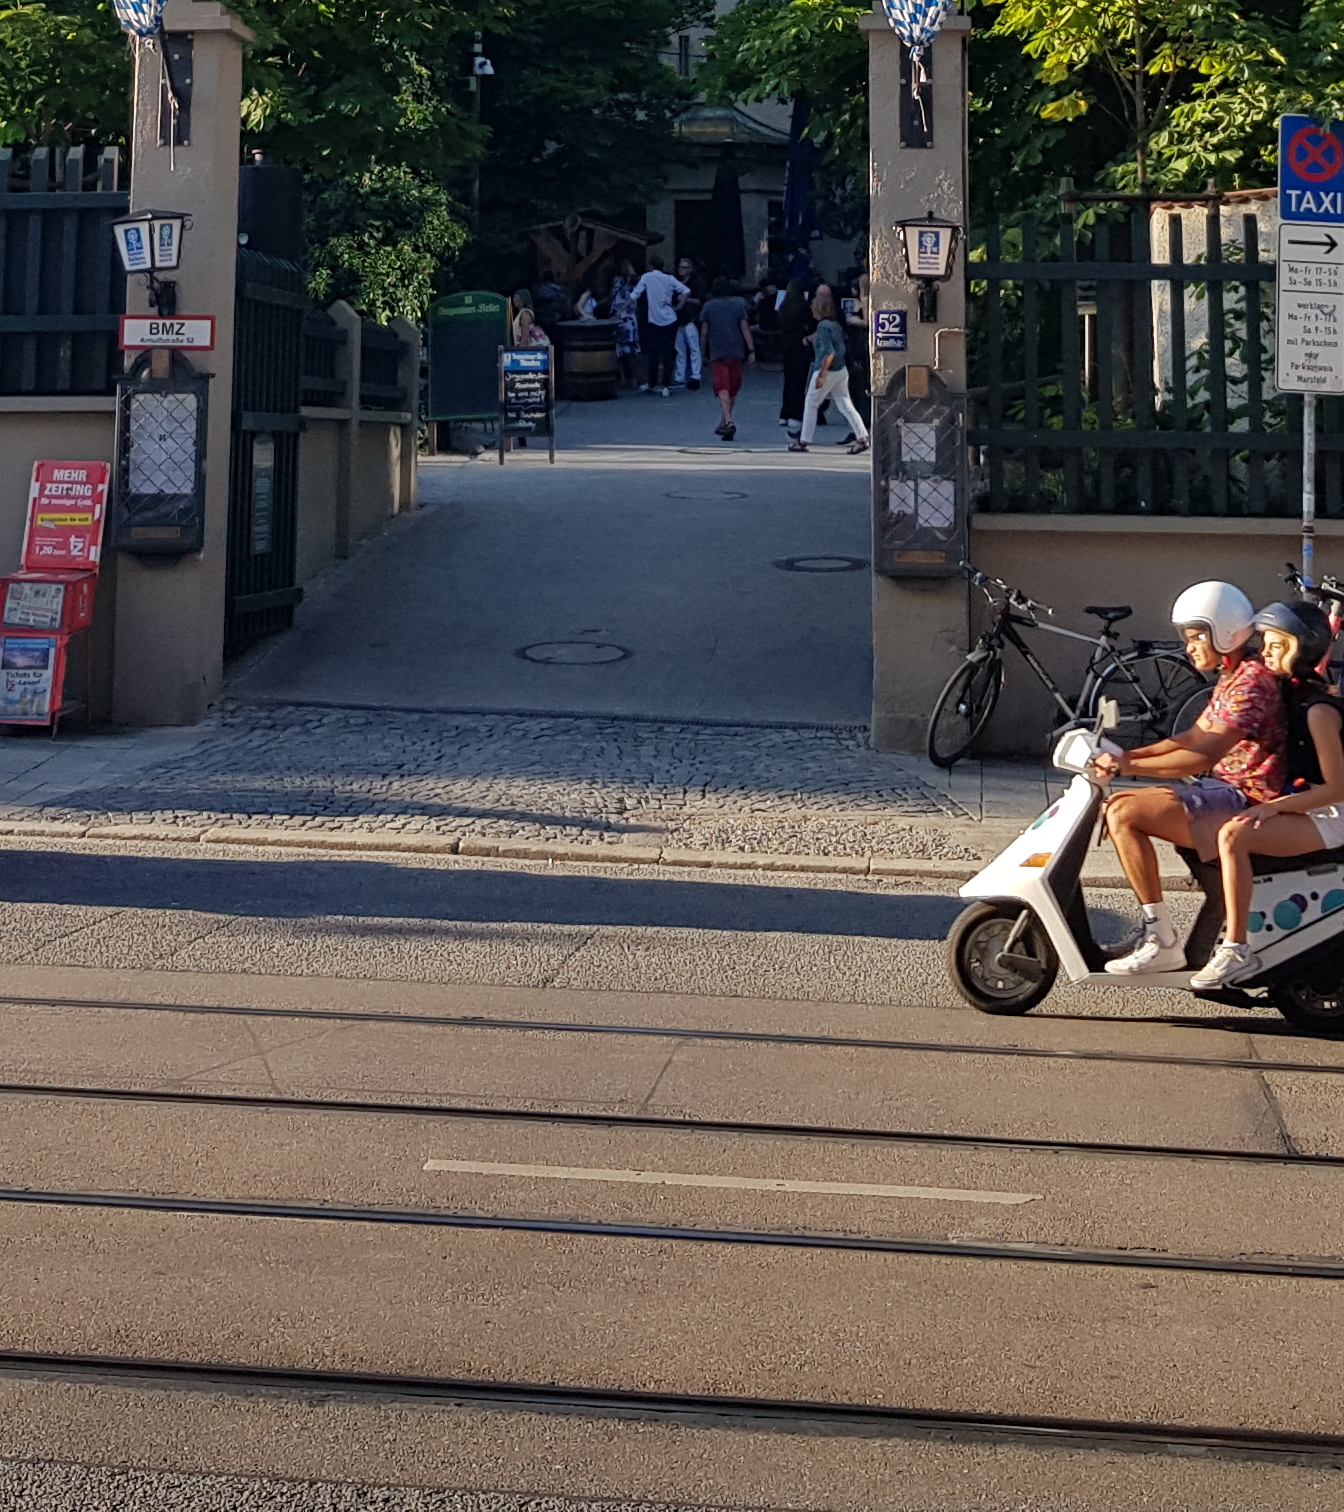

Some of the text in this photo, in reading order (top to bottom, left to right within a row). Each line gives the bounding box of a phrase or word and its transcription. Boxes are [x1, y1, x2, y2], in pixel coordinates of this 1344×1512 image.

[1286, 190, 1342, 215] TAXI
[149, 322, 186, 336] BMZ
[878, 313, 901, 333] 52
[53, 468, 87, 481] MEHR
